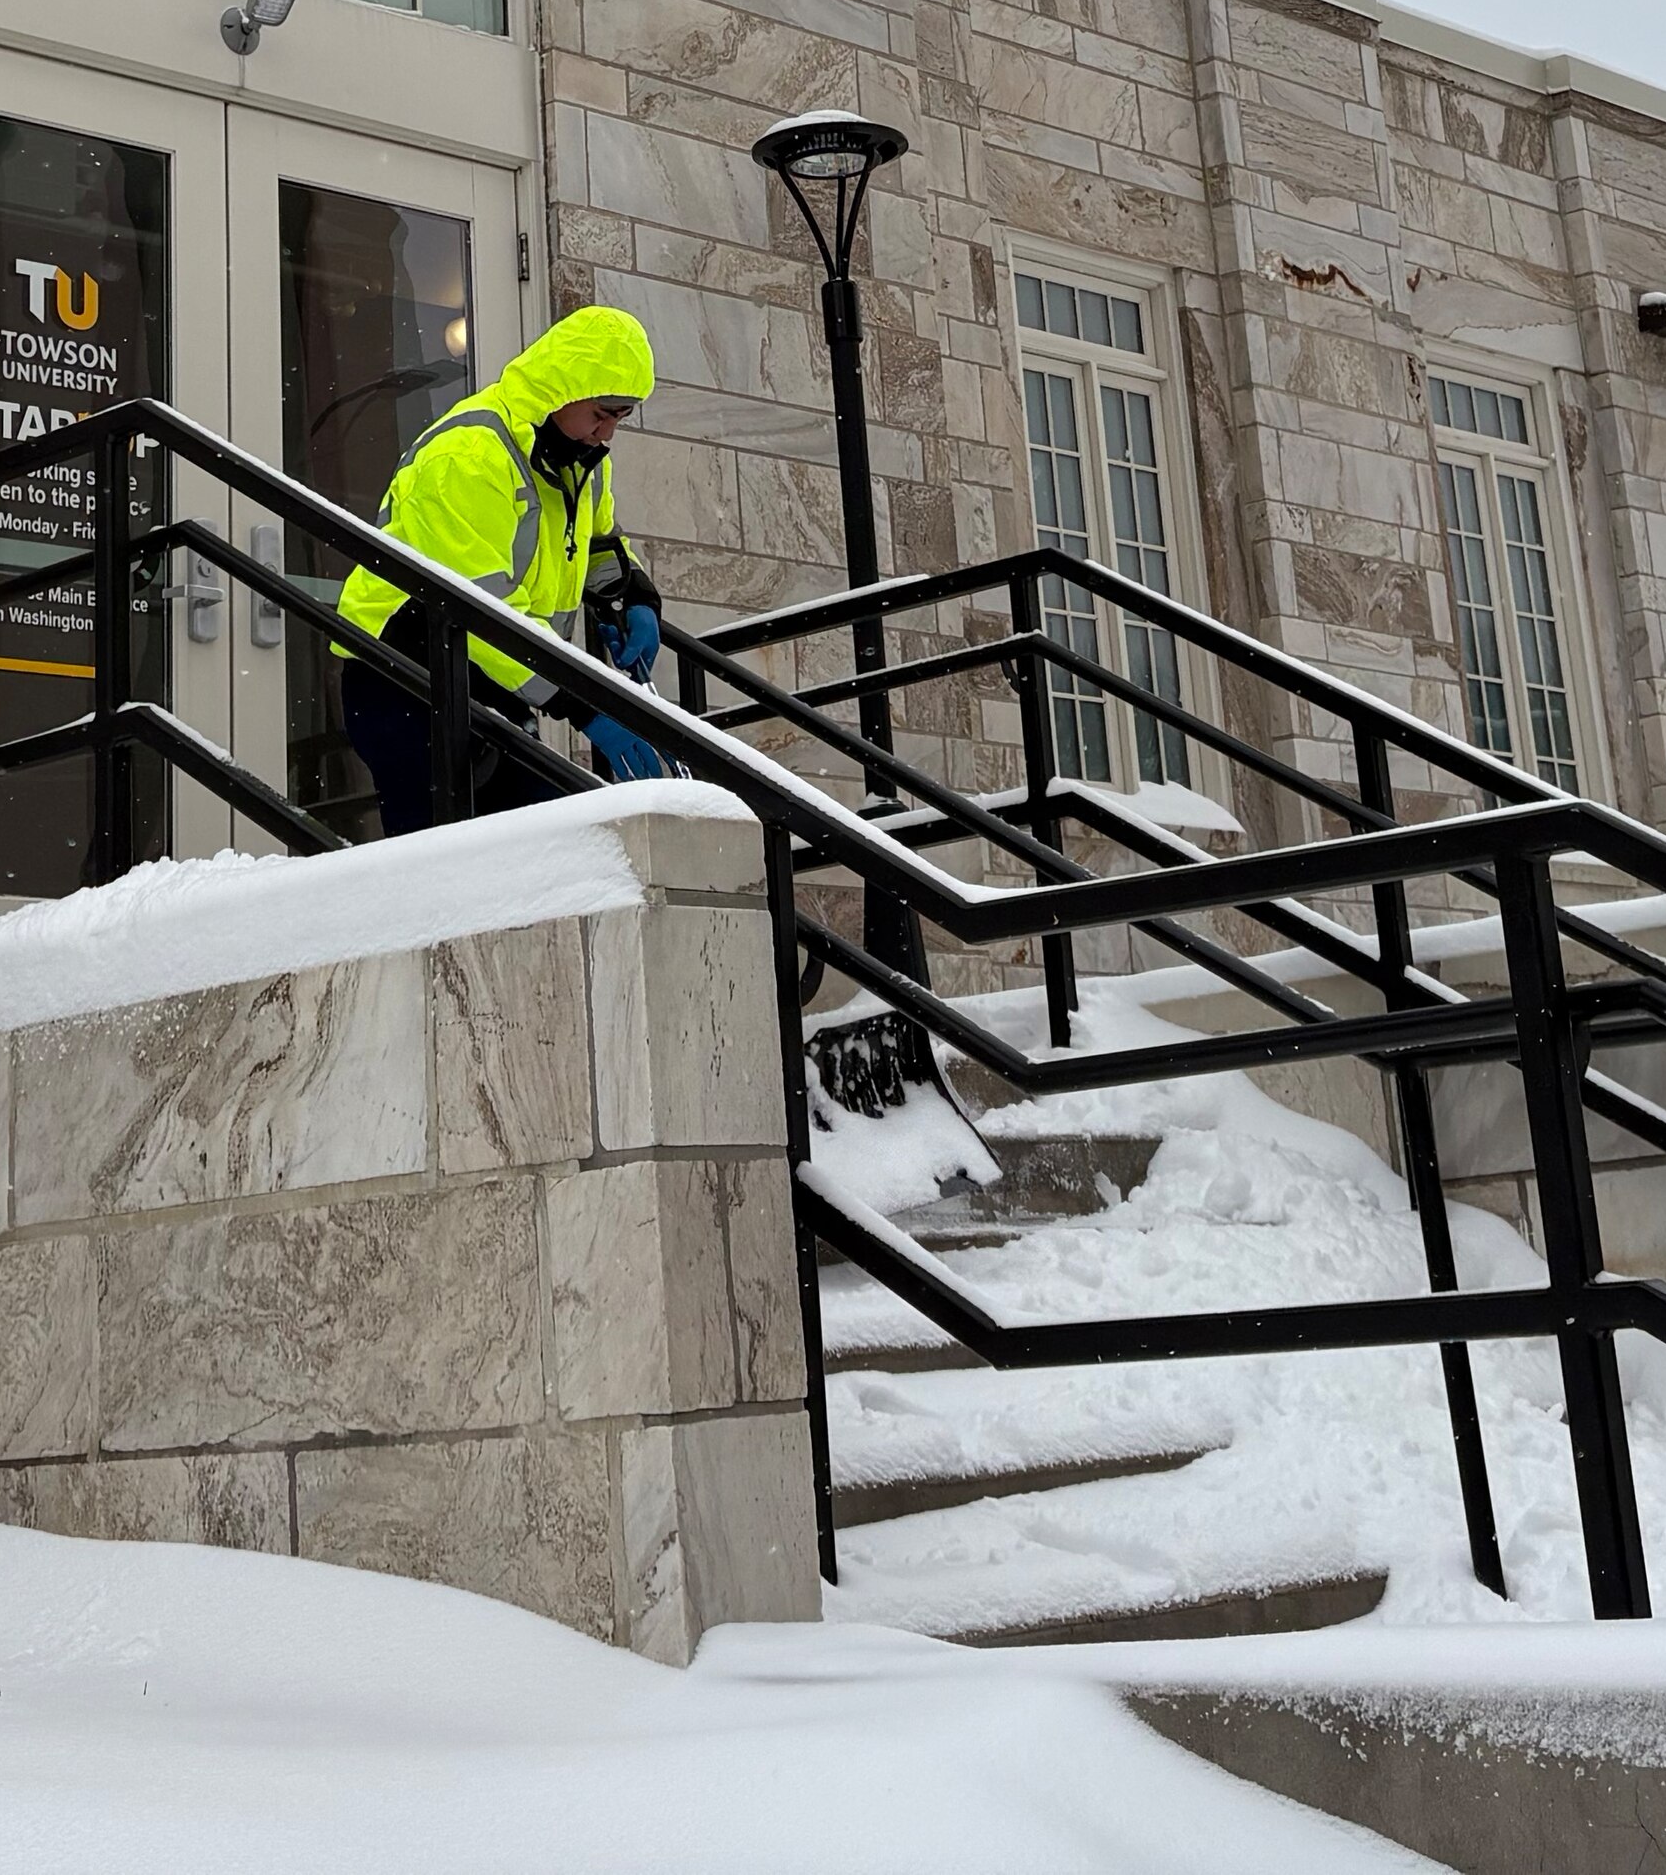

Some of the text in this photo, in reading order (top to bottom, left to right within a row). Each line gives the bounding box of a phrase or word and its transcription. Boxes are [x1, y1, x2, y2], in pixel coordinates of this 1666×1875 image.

[15, 258, 99, 331] TU
[1, 329, 117, 372] TOWSON
[2, 359, 118, 395] UNIVERSITY
[28, 487, 46, 504] to
[52, 488, 81, 509] the
[48, 587, 83, 605] Main
[9, 607, 95, 632] Washington
